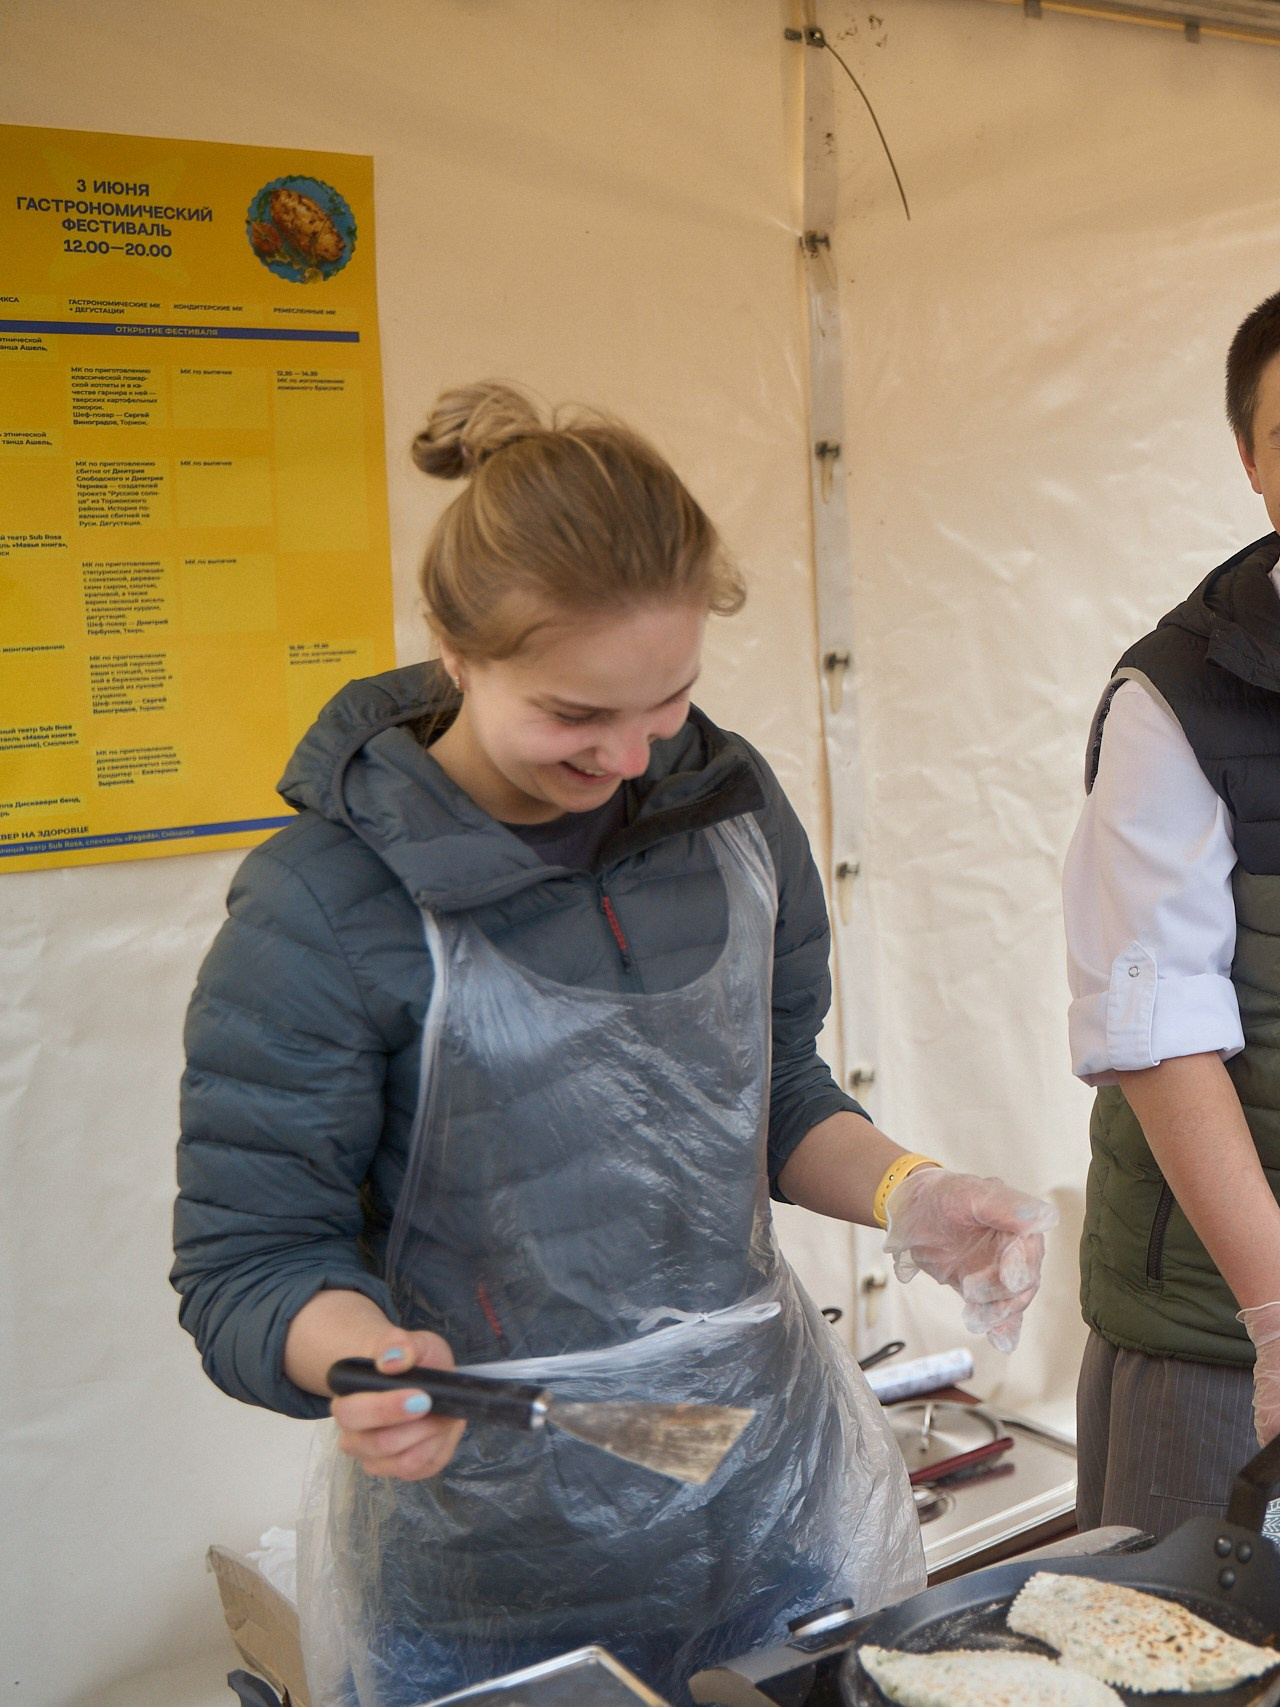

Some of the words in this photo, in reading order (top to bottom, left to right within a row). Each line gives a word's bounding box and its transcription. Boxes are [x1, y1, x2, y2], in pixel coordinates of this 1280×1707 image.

[77, 178, 87, 193] 3
[93, 179, 150, 197] ИЮНЯ
[16, 196, 213, 222] ГАСТРОНОМИЧЕСКИЙ
[61, 217, 172, 237] ФЕСТИВАЛЬ
[68, 299, 148, 308] ГАСТРОНОМИЧЕСКИЕ
[173, 303, 231, 311] КОНДИТЕРСКИЕ
[74, 307, 125, 315] ДЕГУСТАЦИИ
[115, 326, 164, 335] ОТКРЫТИЕ
[165, 328, 219, 336] ФЕСТИВАЛЯ
[20, 344, 48, 352] Ашель,
[0, 832, 20, 841] ВЕР
[21, 830, 36, 839] НА
[37, 826, 90, 838] ЗДОРОВЦЕ
